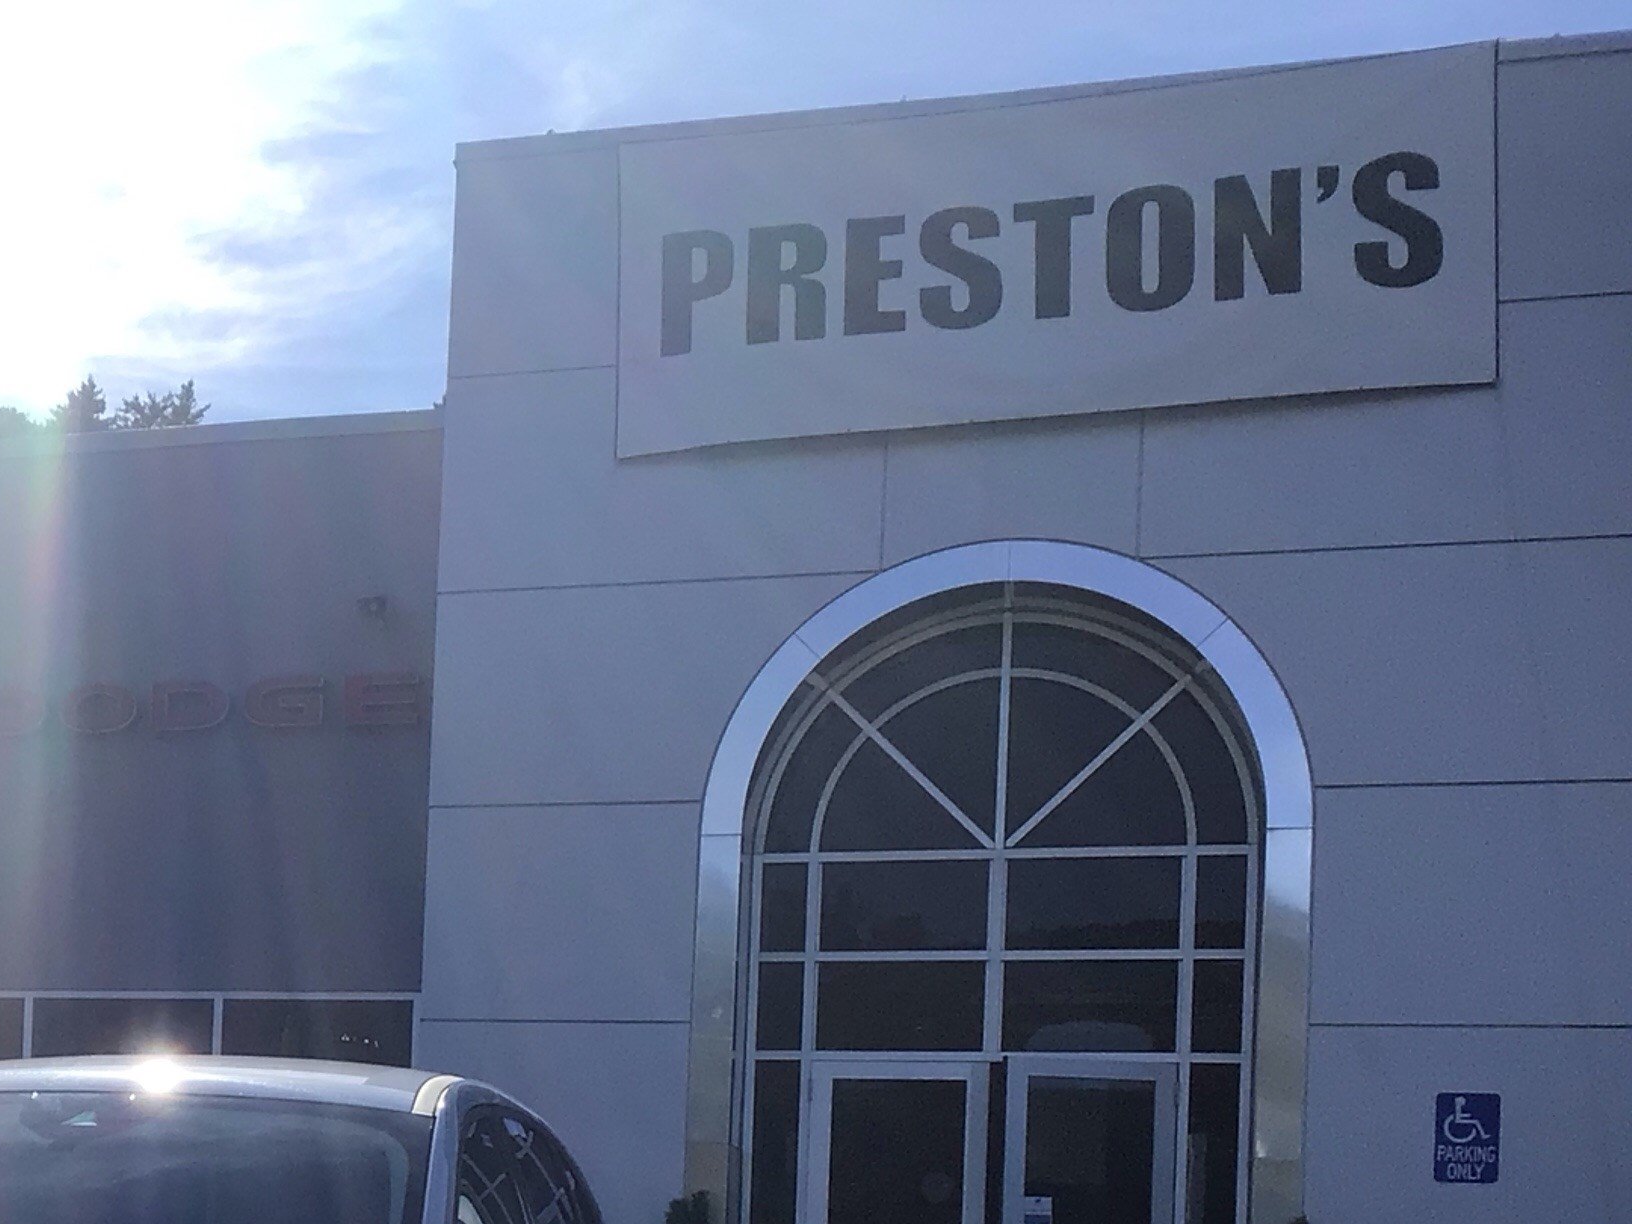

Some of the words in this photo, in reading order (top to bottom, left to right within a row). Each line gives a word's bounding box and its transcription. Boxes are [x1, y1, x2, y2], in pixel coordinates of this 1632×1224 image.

[661, 151, 1444, 357] PRESTON'S
[1436, 1145, 1497, 1163] PARKING
[1447, 1163, 1485, 1180] ONLY
